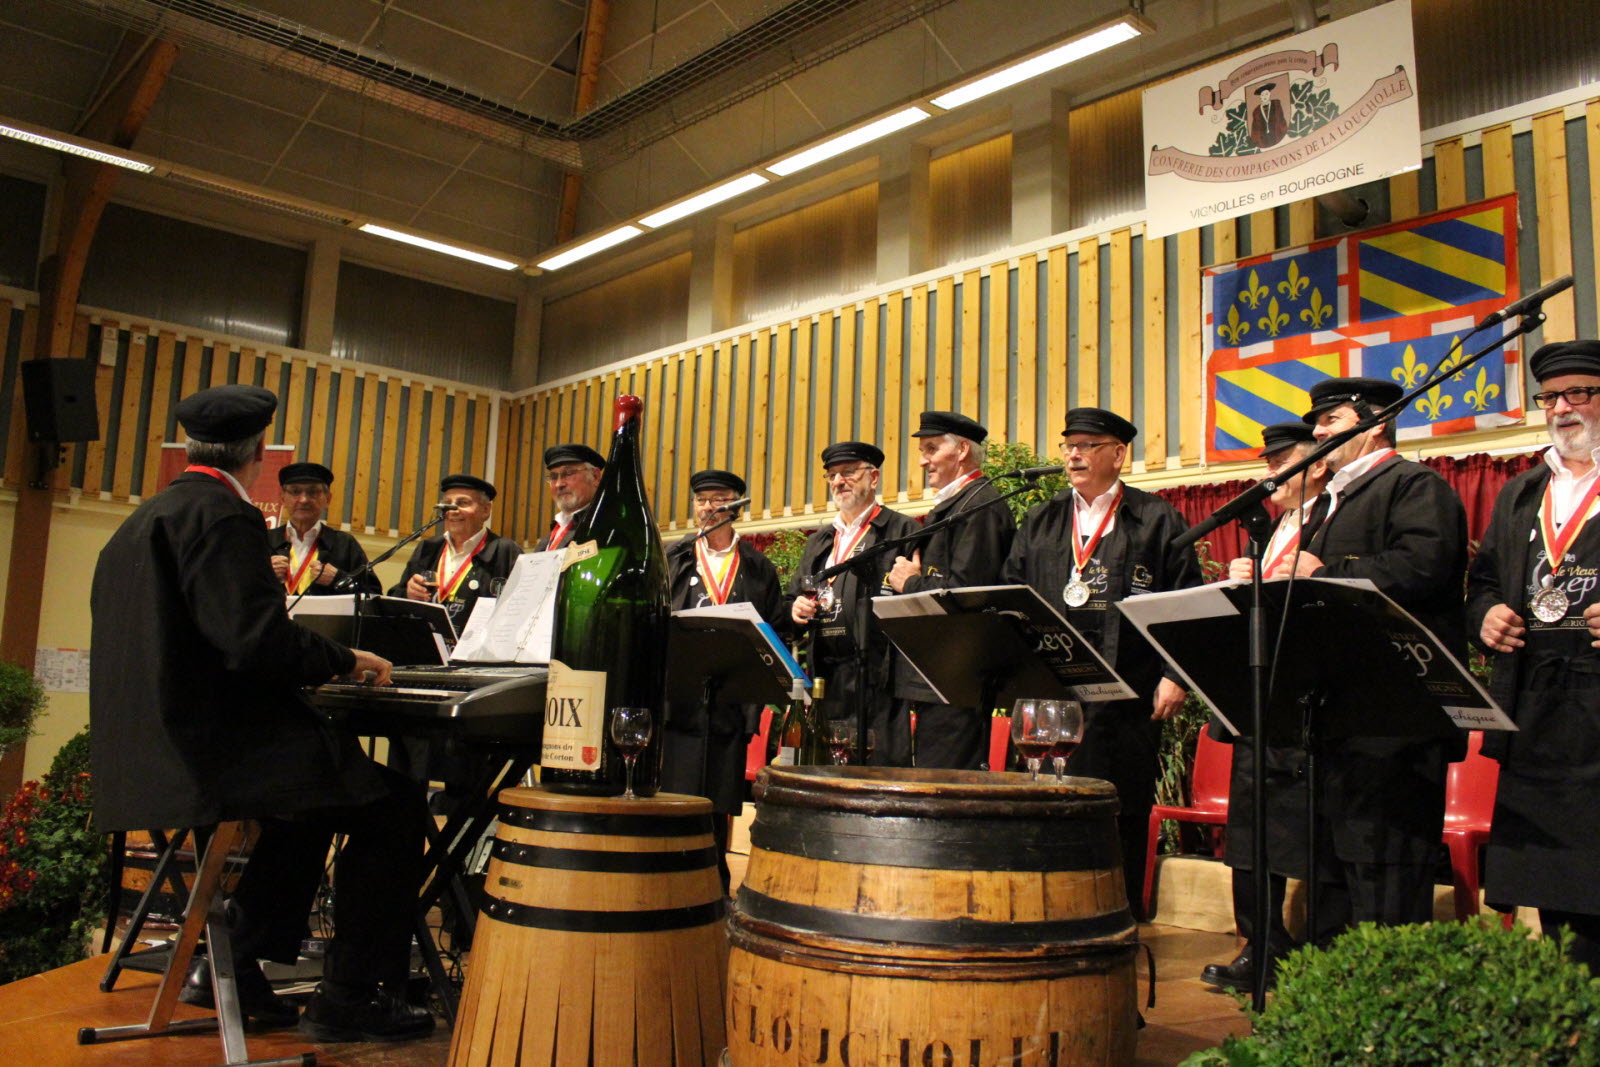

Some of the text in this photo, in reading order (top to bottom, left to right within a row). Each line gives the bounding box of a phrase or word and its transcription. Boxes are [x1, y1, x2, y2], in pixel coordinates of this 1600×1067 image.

[1151, 79, 1407, 178] CONFRERIE DES COMPAGNONS DE LA LOUCHOLLE
[1189, 163, 1365, 219] VIGNOLLES en BOURGOGNE
[545, 696, 584, 728] OIX
[1450, 709, 1497, 724] chique
